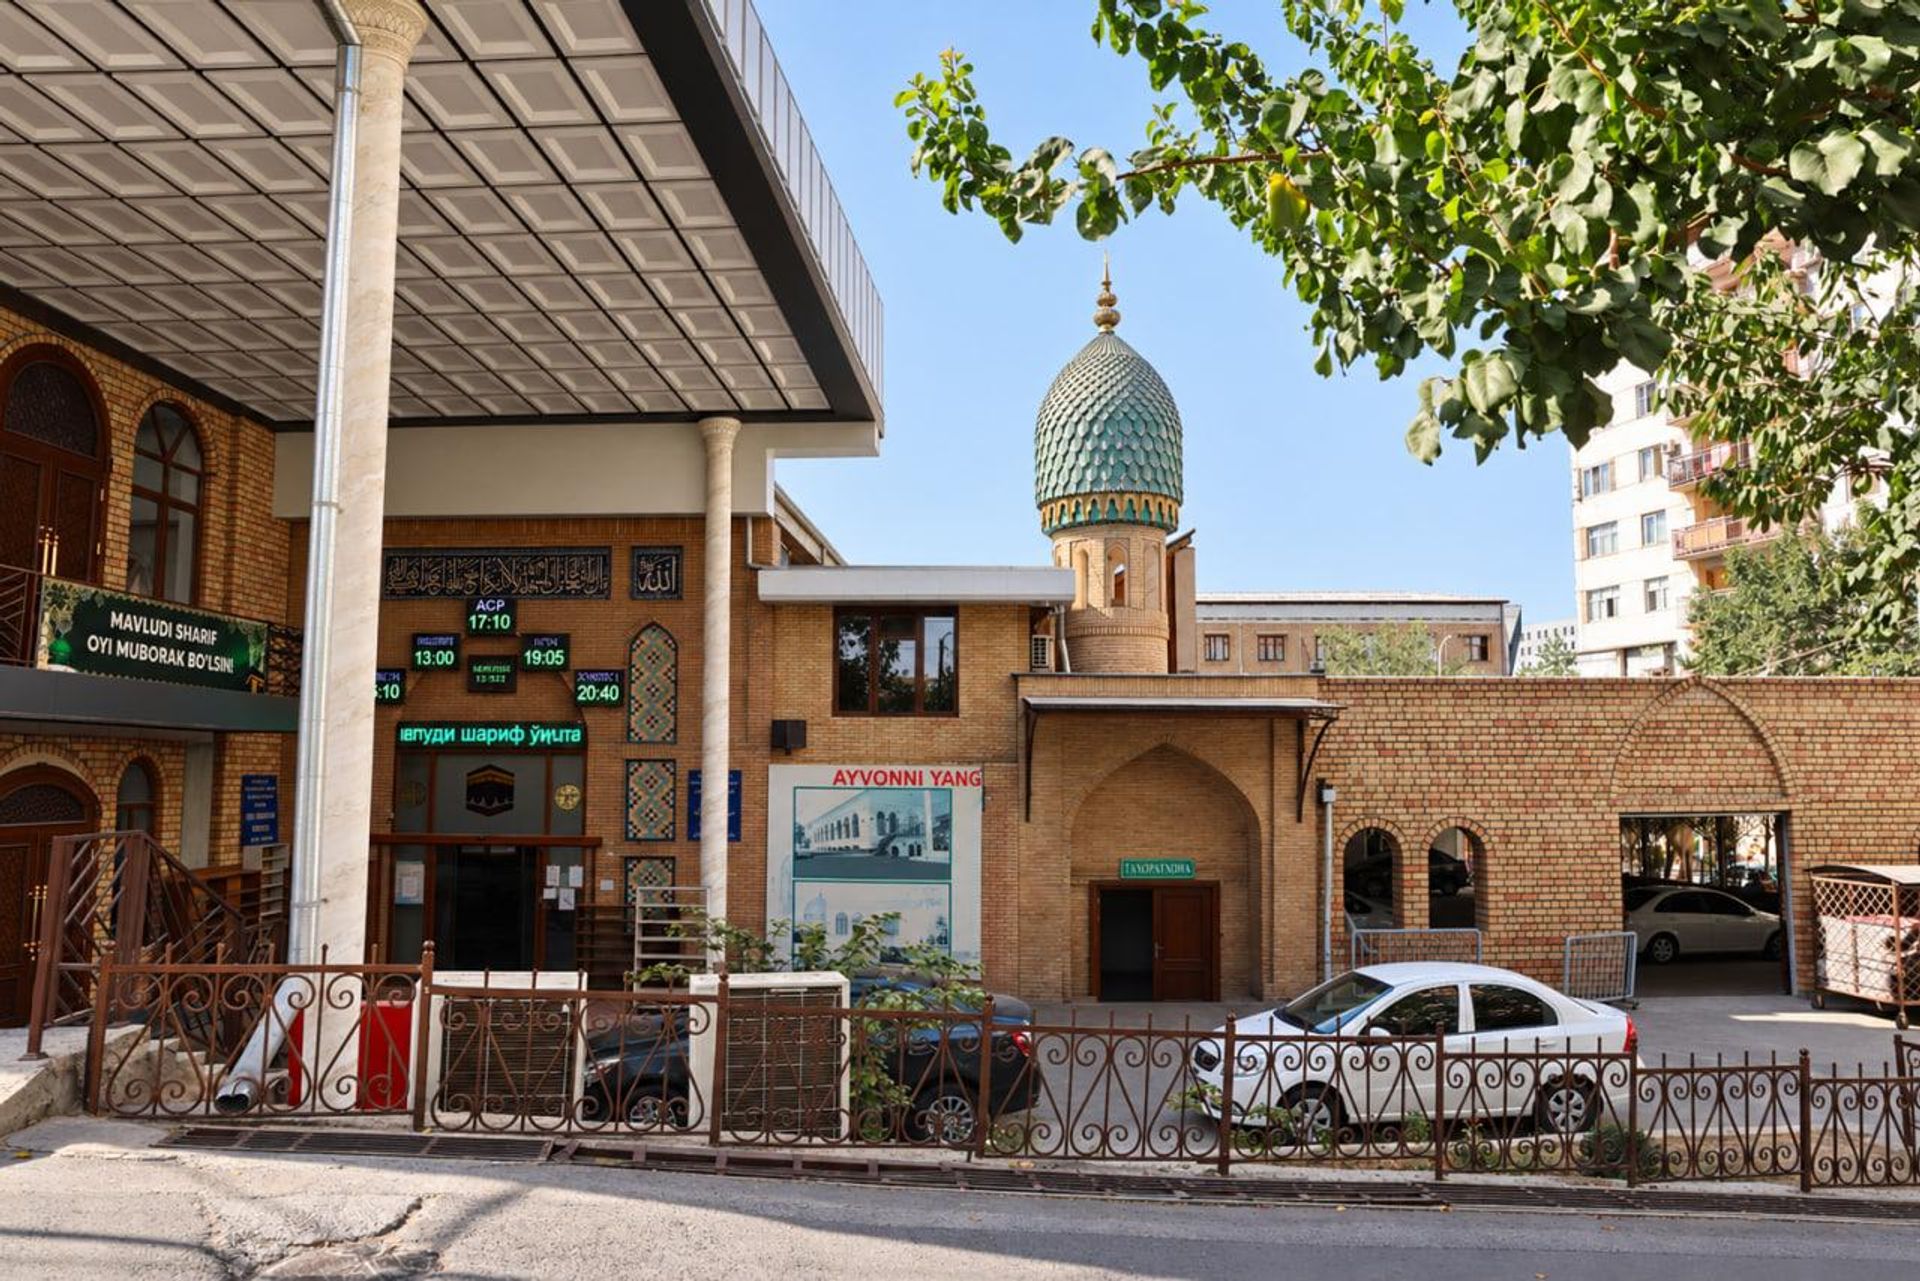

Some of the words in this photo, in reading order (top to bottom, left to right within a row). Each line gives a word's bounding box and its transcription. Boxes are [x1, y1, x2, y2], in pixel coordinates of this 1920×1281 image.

[476, 600, 506, 611] АСР
[110, 611, 173, 638] MAVLUDI
[175, 623, 218, 645] SHARIF
[469, 614, 511, 629] 17:10
[87, 635, 113, 656] OYI
[116, 640, 186, 667] MUBORAK
[188, 651, 234, 673] BO'LSIN!
[415, 651, 455, 665] 13:00
[524, 650, 565, 665] 19:05
[577, 685, 620, 701] 20:40
[460, 725, 525, 745] шариф
[833, 769, 924, 786] AYVONNI
[930, 769, 982, 786] YANG
